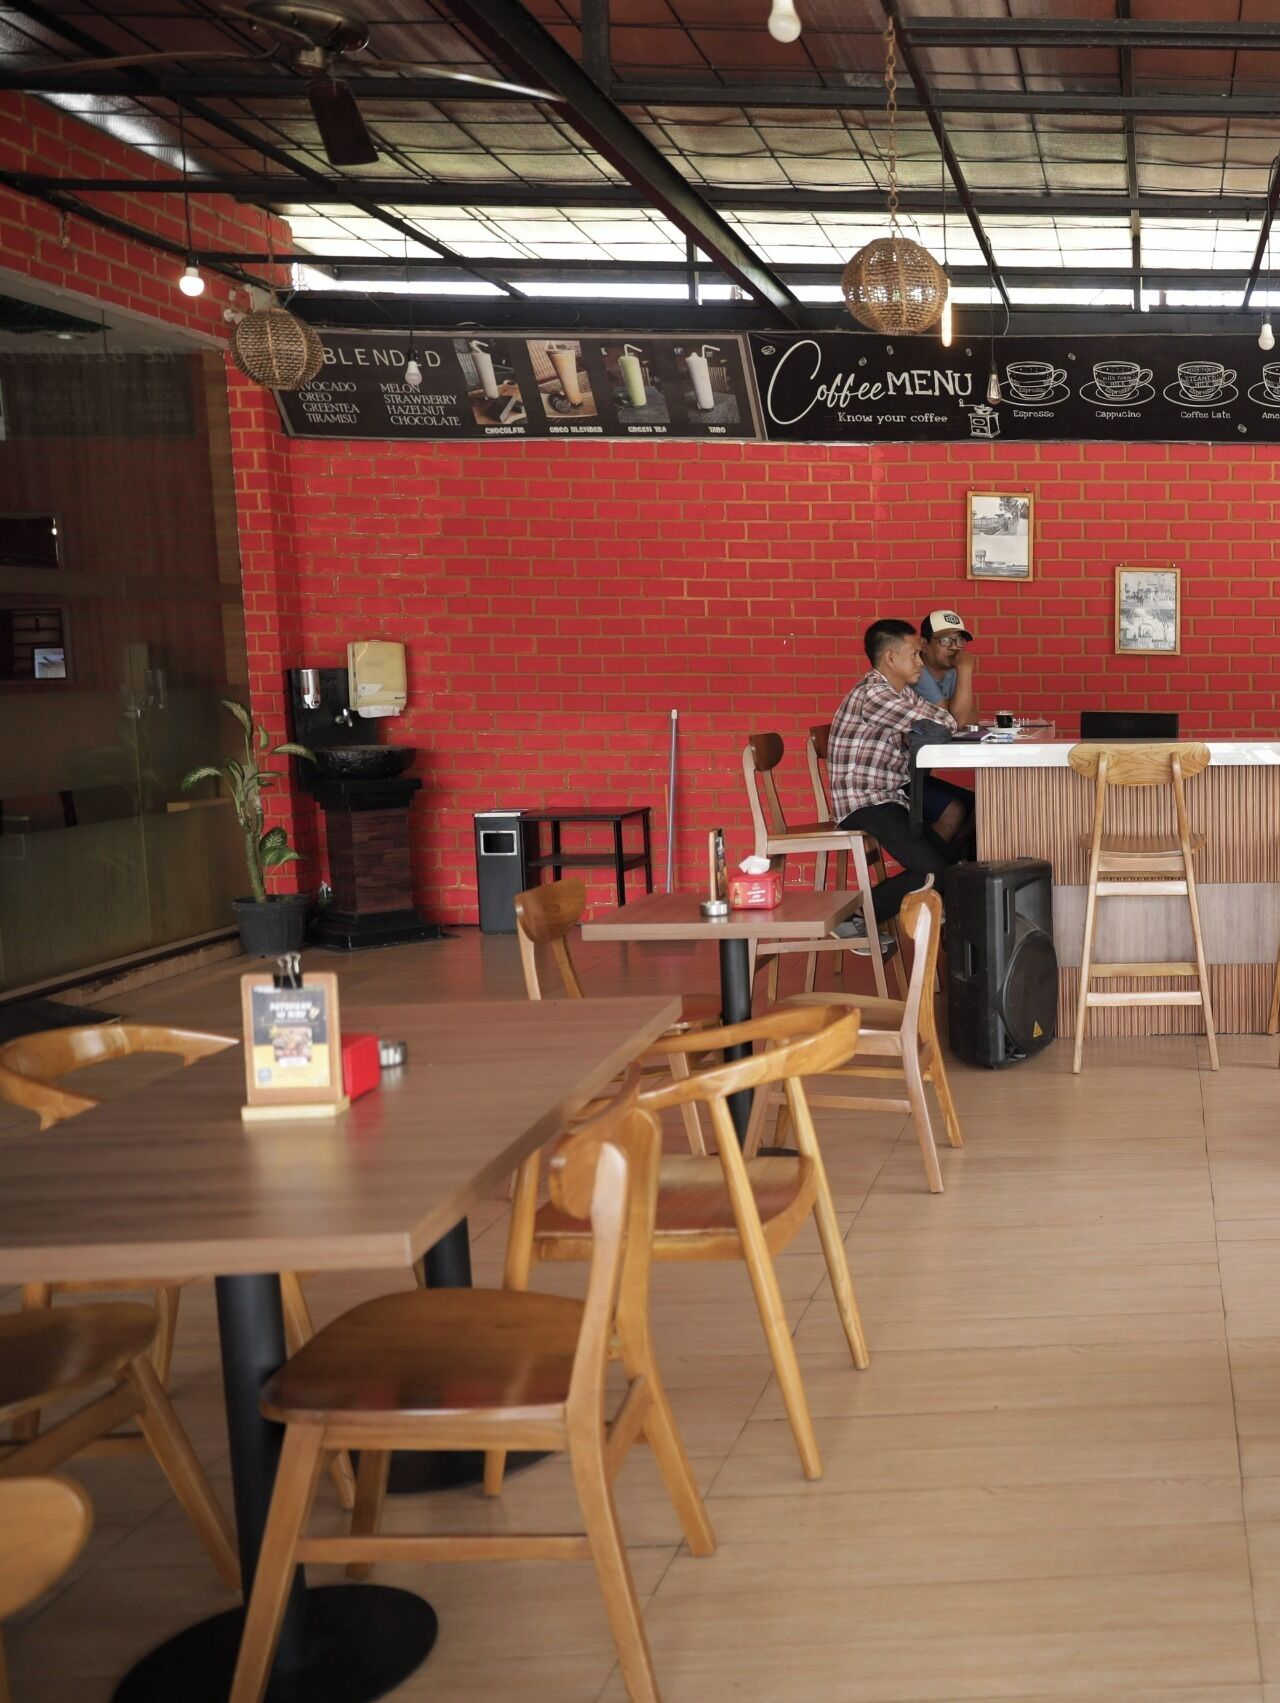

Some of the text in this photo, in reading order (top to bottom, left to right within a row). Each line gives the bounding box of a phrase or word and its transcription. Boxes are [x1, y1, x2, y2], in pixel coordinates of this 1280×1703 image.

[767, 339, 973, 426] Coffee MENU
[380, 383, 421, 394] MELON
[298, 391, 332, 402] OREO
[384, 394, 457, 405] STRAWBERRY
[303, 402, 360, 414] GREENTEA
[387, 404, 446, 416] HAZELNUT
[305, 413, 358, 424] TIRAMISU
[837, 411, 948, 425] Know your coffee
[1012, 409, 1055, 420] Espresso
[1095, 410, 1141, 420] Cappucino
[1181, 411, 1231, 419] Coffee Late
[390, 416, 462, 427] CHOCOLATE
